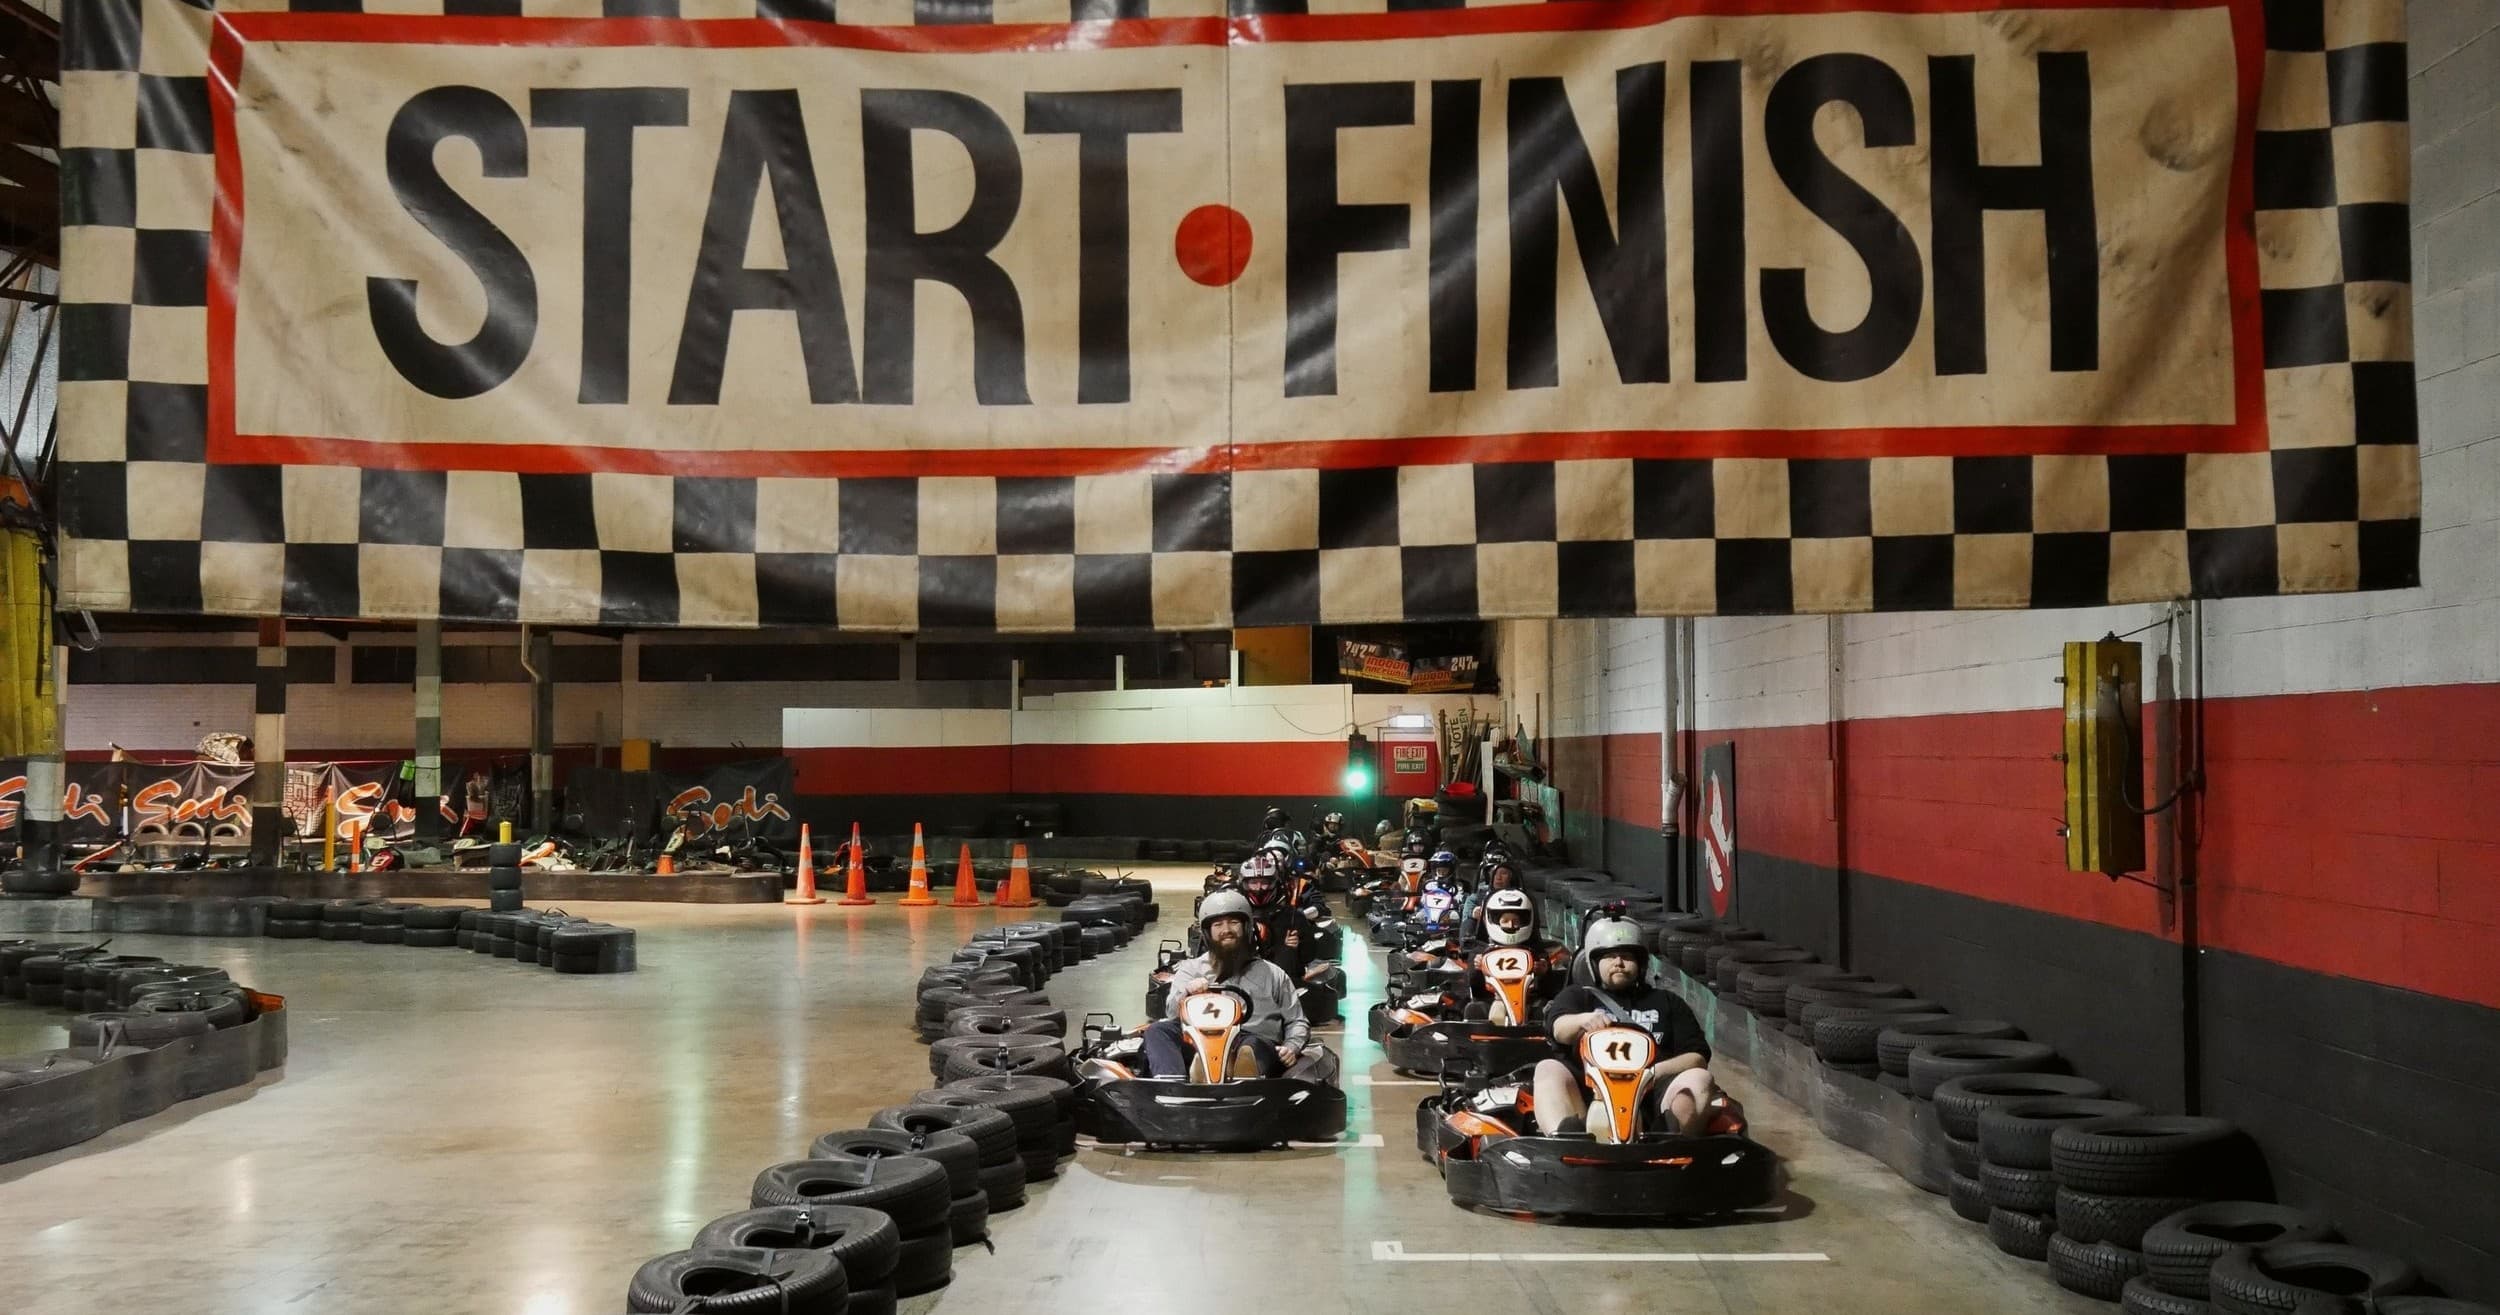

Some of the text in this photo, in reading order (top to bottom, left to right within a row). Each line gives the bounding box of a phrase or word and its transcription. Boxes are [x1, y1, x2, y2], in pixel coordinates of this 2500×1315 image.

[367, 50, 2099, 405] START FINISH
[1450, 717, 1462, 749] VOTE
[1411, 748, 1424, 758] EXIT
[1432, 897, 1443, 906] 7
[1496, 957, 1522, 971] 12
[1202, 1002, 1221, 1019] 4
[1605, 1042, 1632, 1061] 11
